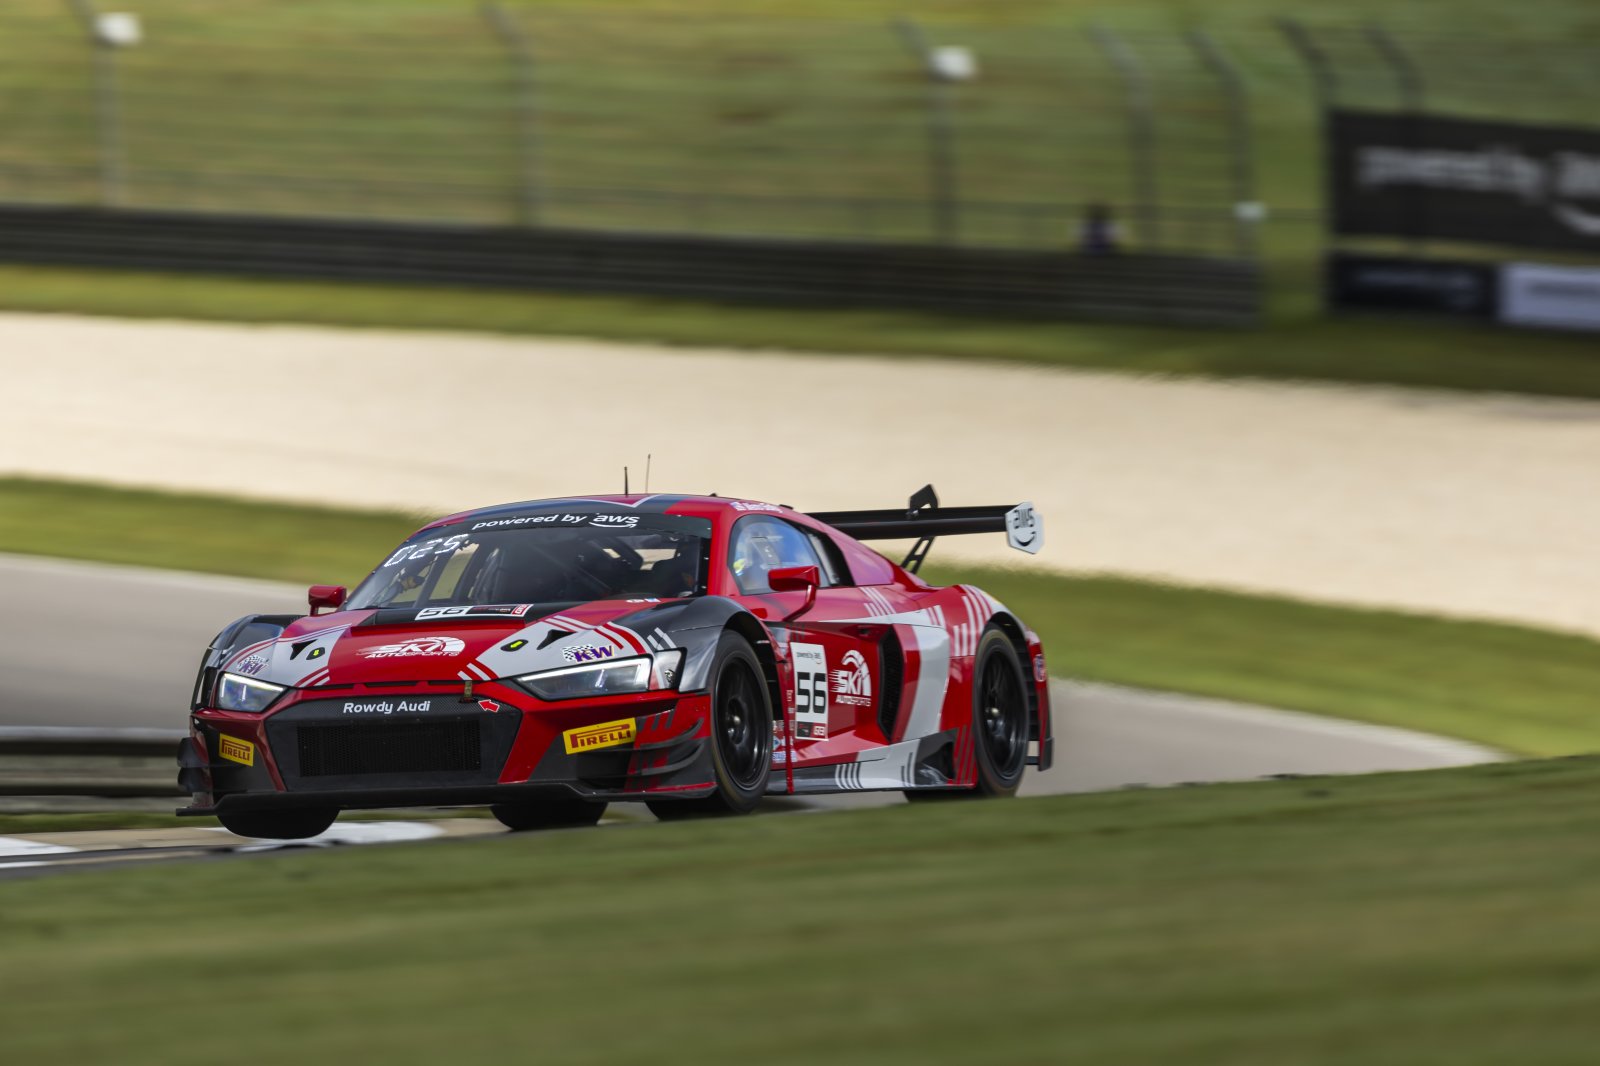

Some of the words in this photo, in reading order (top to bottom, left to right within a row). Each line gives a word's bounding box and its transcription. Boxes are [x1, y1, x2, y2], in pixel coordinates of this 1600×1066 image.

[472, 514, 559, 530] powered
[561, 514, 587, 523] by
[593, 514, 640, 526] aws
[364, 651, 460, 659] AUTOSPORTS
[573, 645, 614, 663] KW
[796, 671, 827, 714] 56
[343, 702, 394, 715] Rowdy
[397, 700, 431, 712] Audi
[569, 723, 632, 749] PIRELLI
[221, 738, 251, 761] PIRELLI
